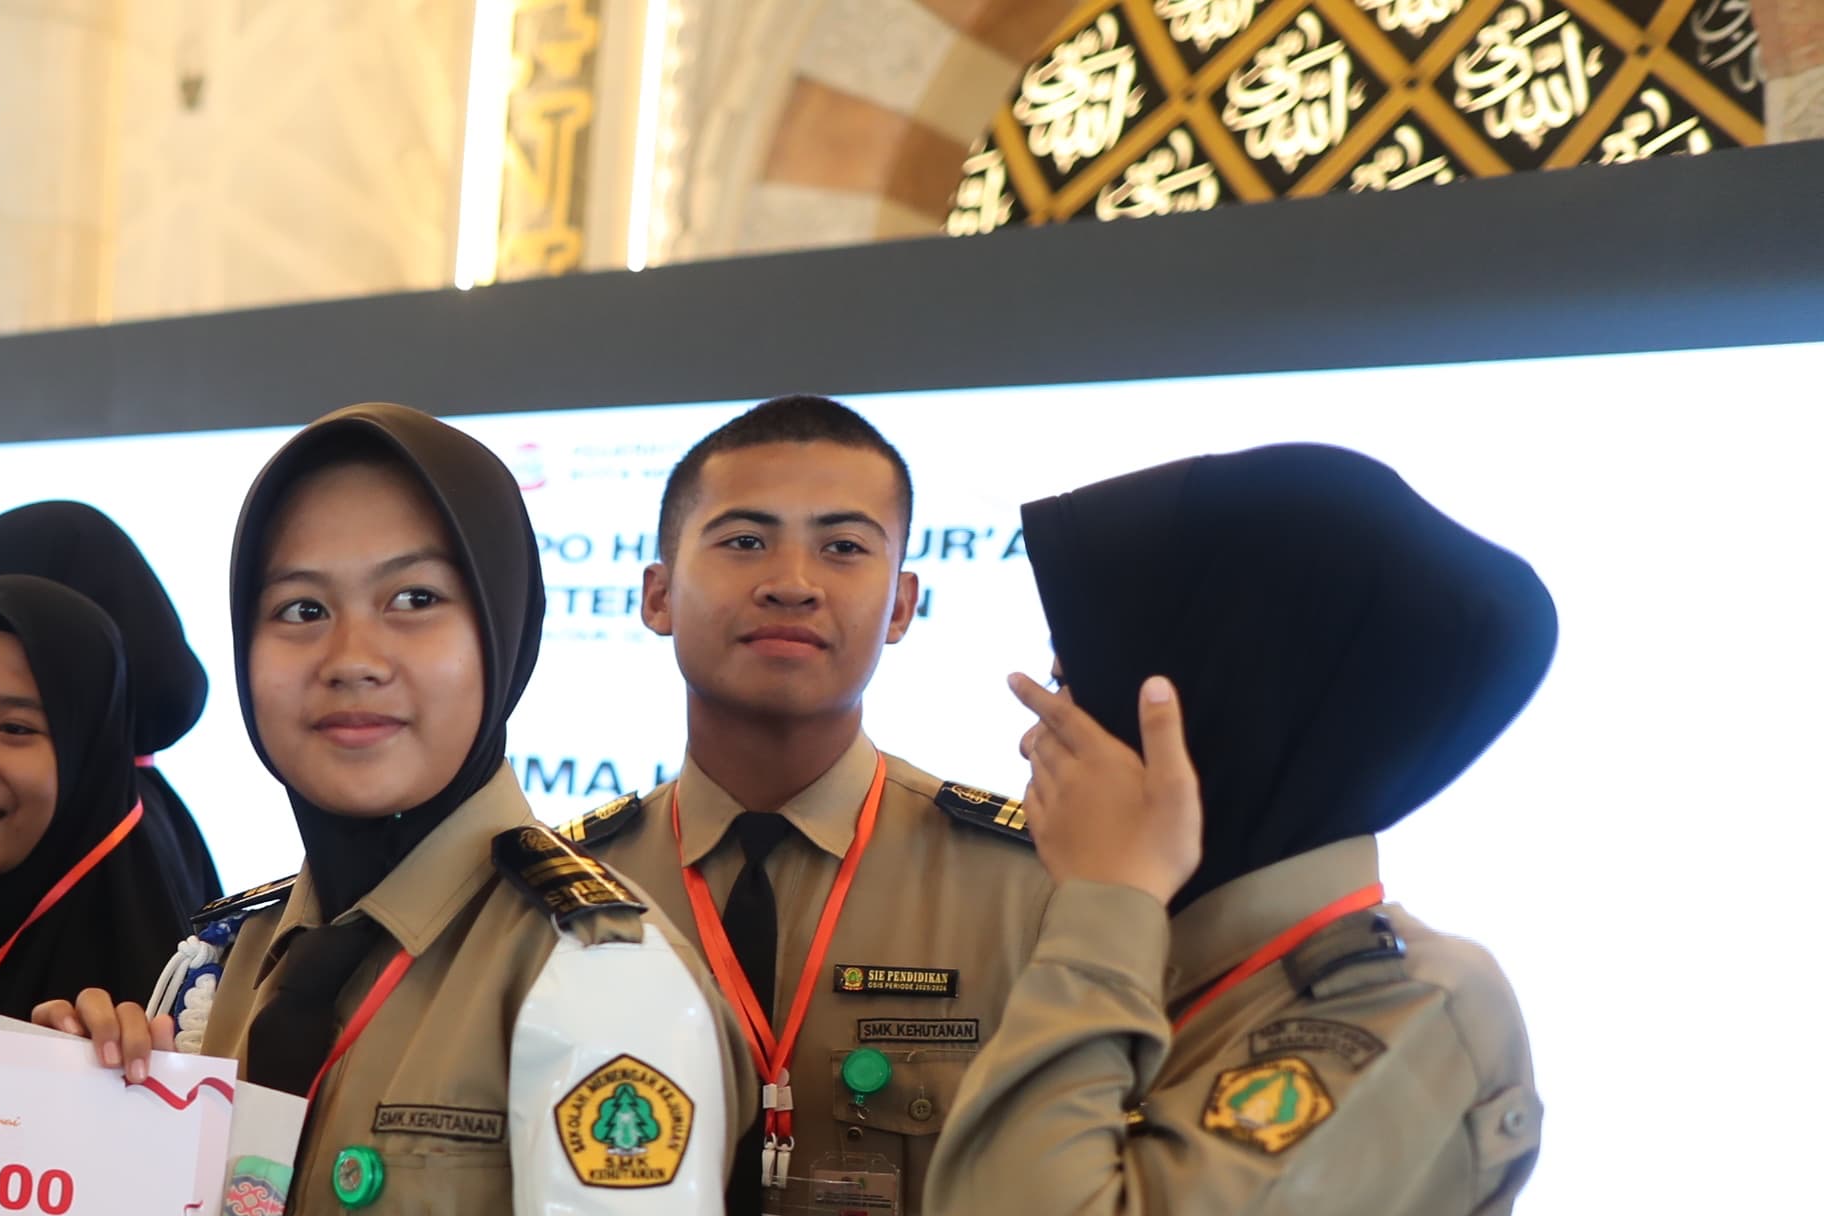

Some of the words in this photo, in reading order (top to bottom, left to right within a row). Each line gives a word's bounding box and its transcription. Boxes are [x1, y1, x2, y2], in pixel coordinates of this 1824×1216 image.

[868, 970, 885, 981] SIE
[887, 971, 949, 983] PENDIDIKAN
[863, 1024, 893, 1038] SMK
[896, 1024, 974, 1038] KEHUTANAN
[409, 1112, 497, 1135] KEHUTANAN
